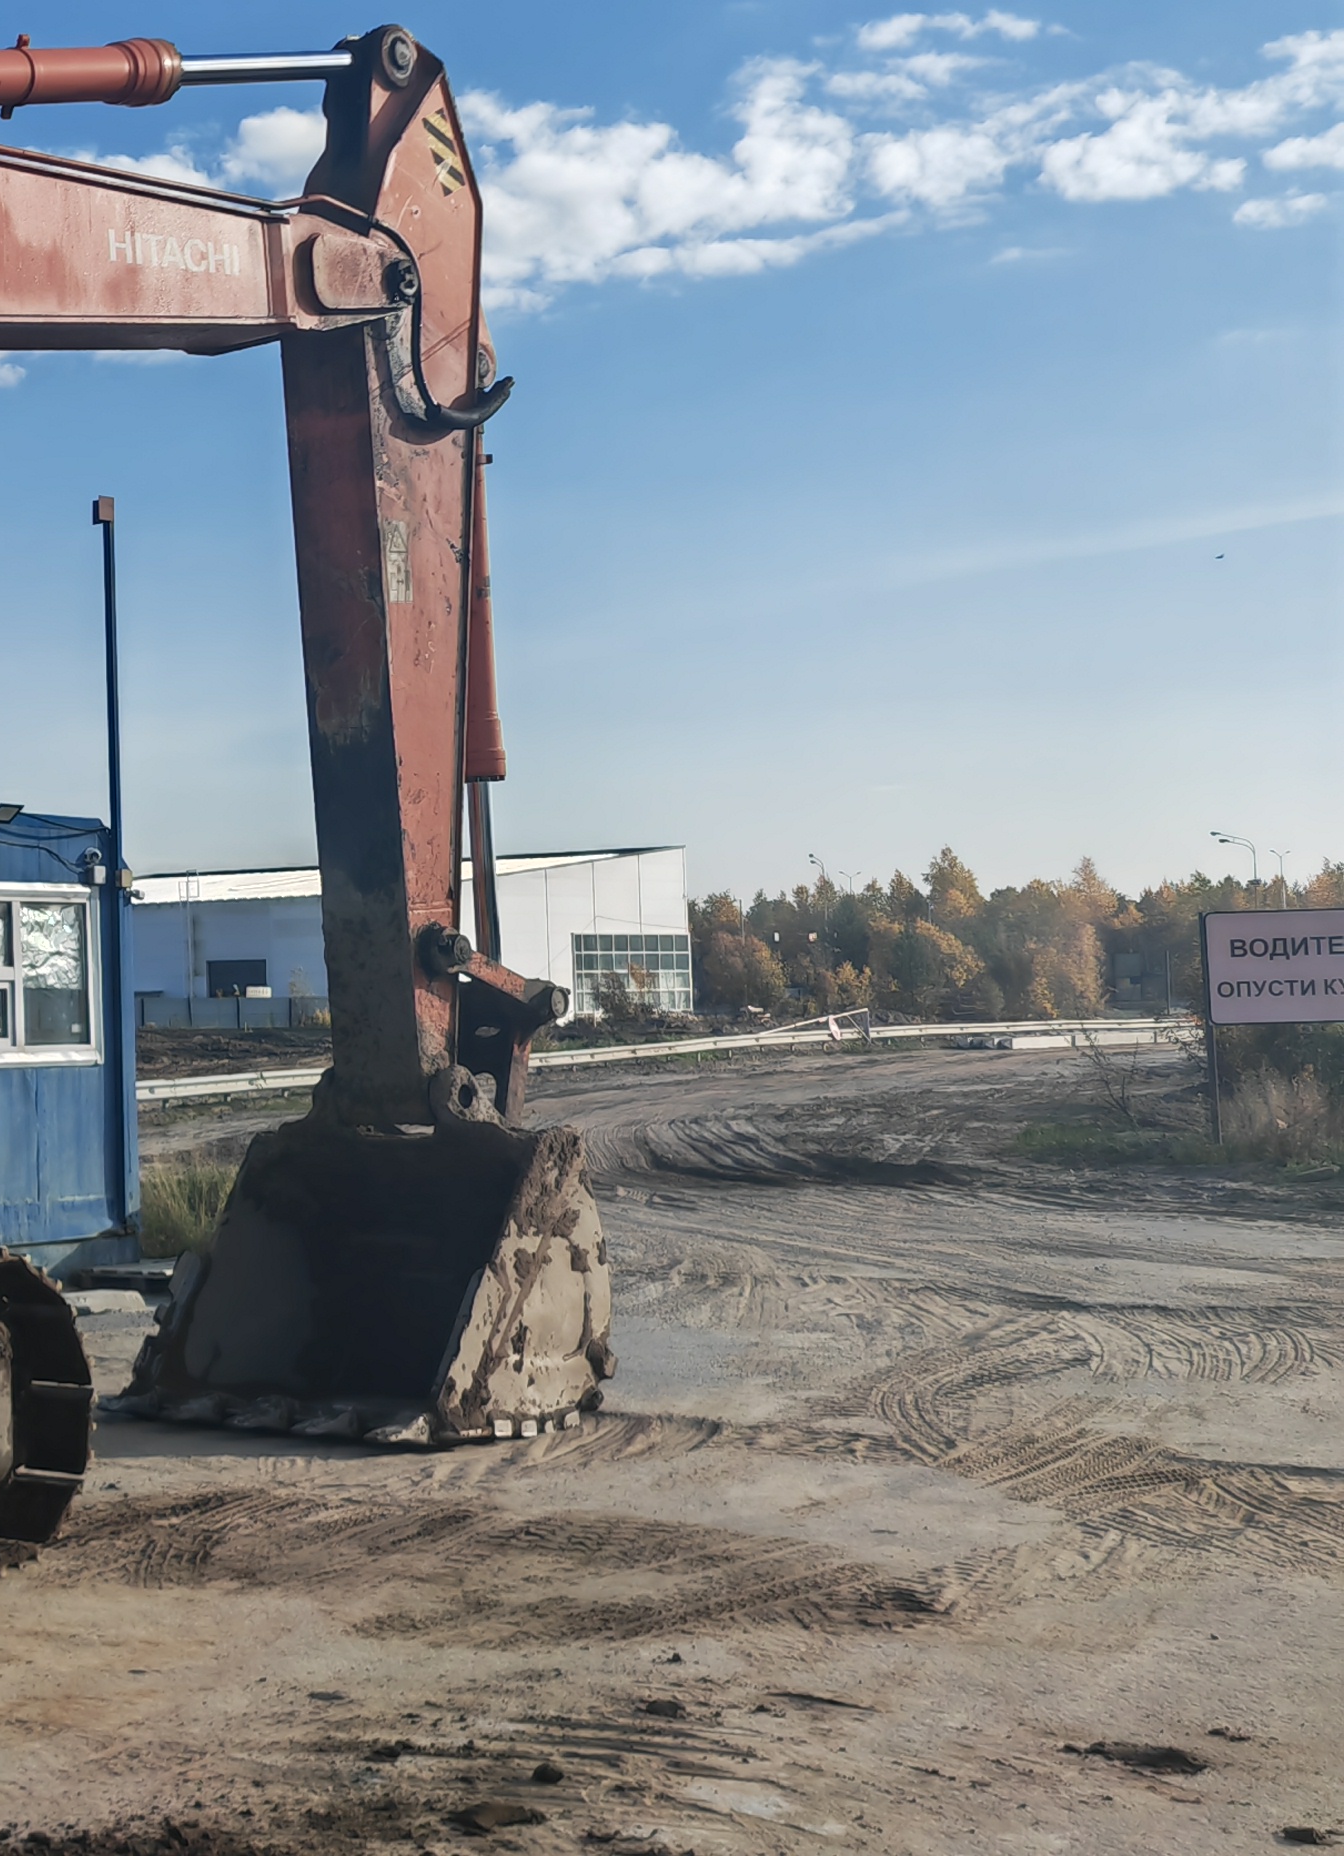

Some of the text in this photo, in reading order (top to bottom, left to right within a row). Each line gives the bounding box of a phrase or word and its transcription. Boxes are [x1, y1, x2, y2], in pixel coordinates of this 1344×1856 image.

[107, 228, 240, 275] HITACHI
[1230, 936, 1344, 960] ВОДИТЕ
[1217, 979, 1315, 998] ОПУСТИ
